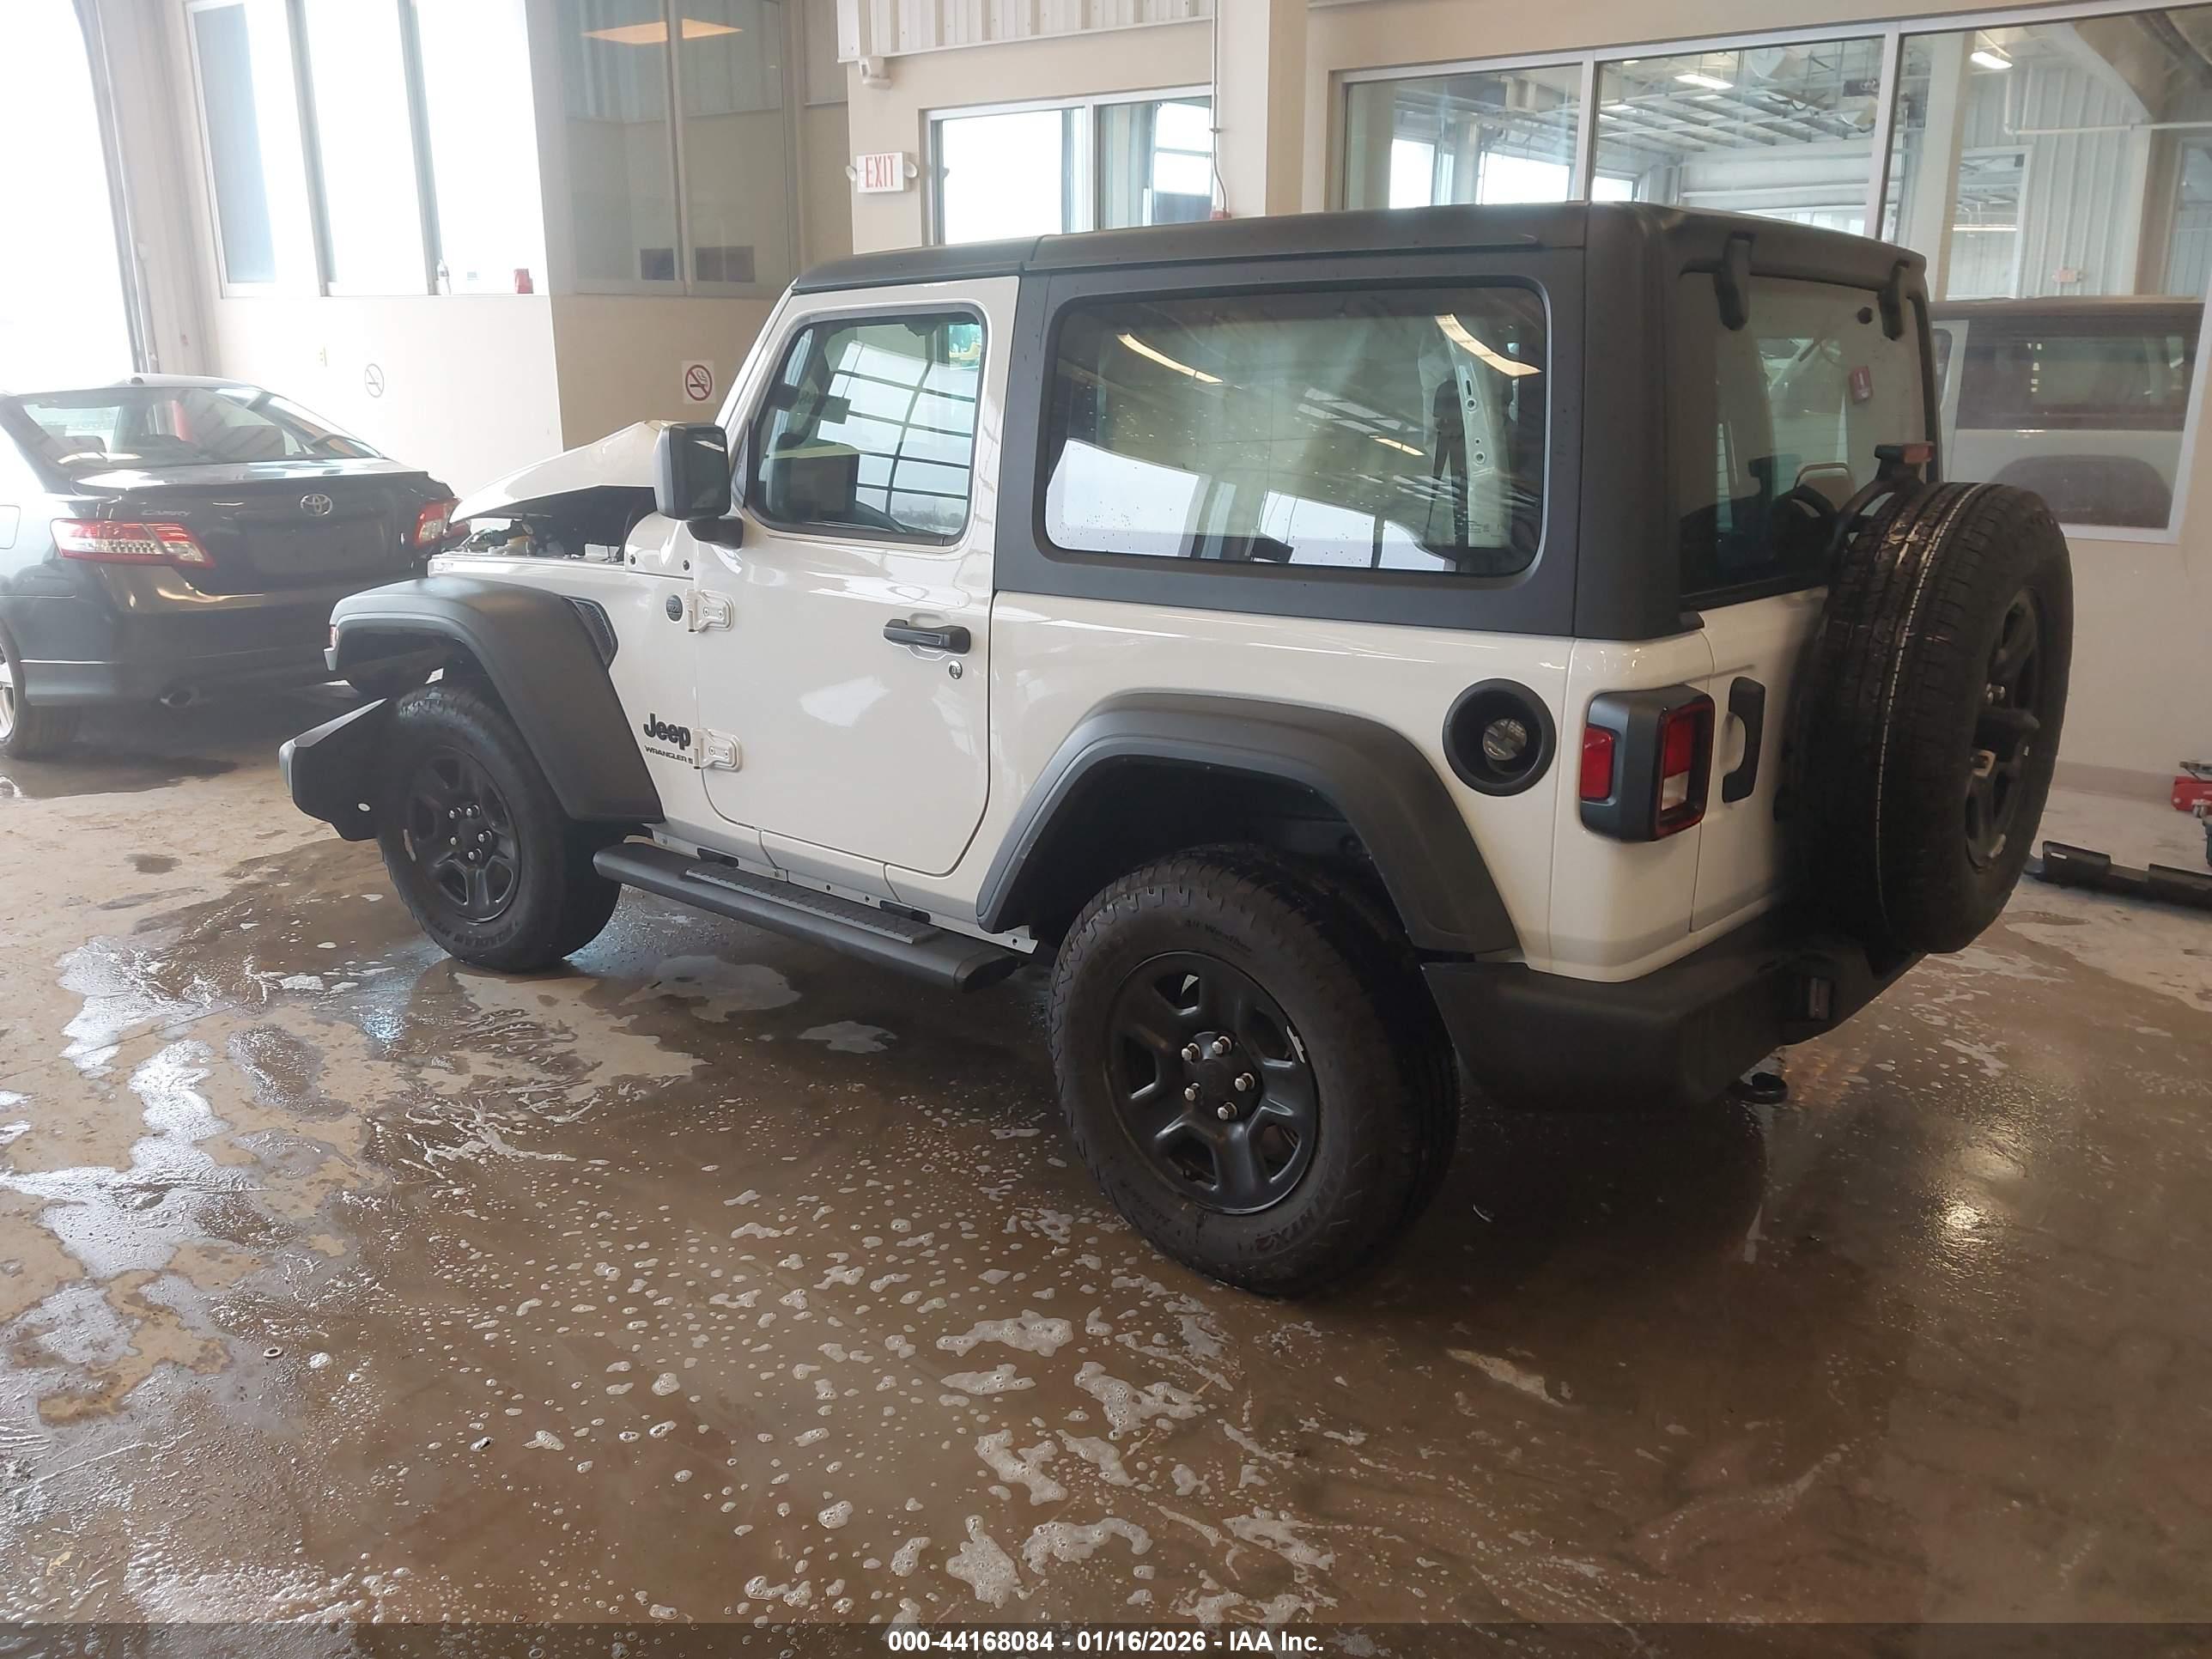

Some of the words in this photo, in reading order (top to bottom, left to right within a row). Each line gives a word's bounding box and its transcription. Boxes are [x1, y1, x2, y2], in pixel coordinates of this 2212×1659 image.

[865, 155, 895, 188] EXIT
[643, 713, 691, 750] Jeep
[644, 744, 687, 763] WRANGLER
